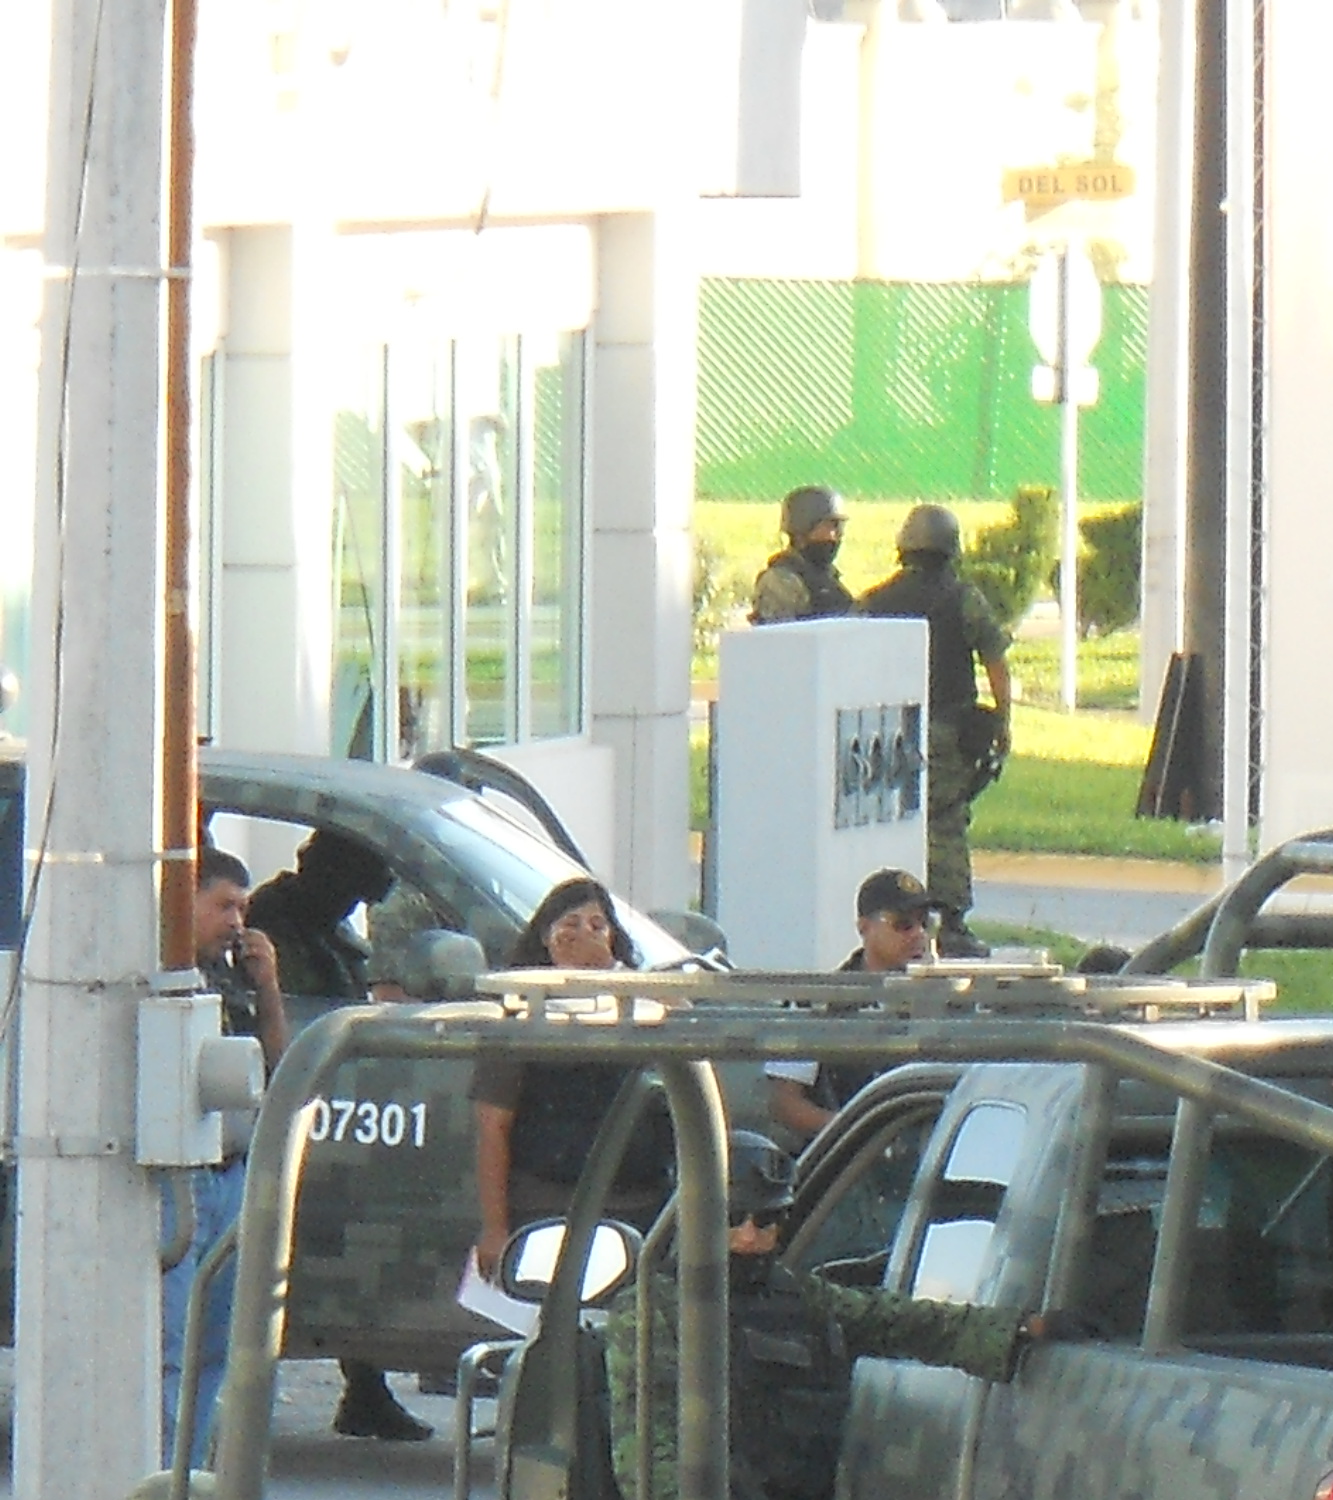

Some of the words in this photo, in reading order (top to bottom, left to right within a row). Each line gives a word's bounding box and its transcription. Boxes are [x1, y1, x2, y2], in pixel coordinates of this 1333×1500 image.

[1018, 174, 1065, 194] DEL
[1075, 173, 1123, 193] SOL
[309, 1098, 427, 1148] 07301
